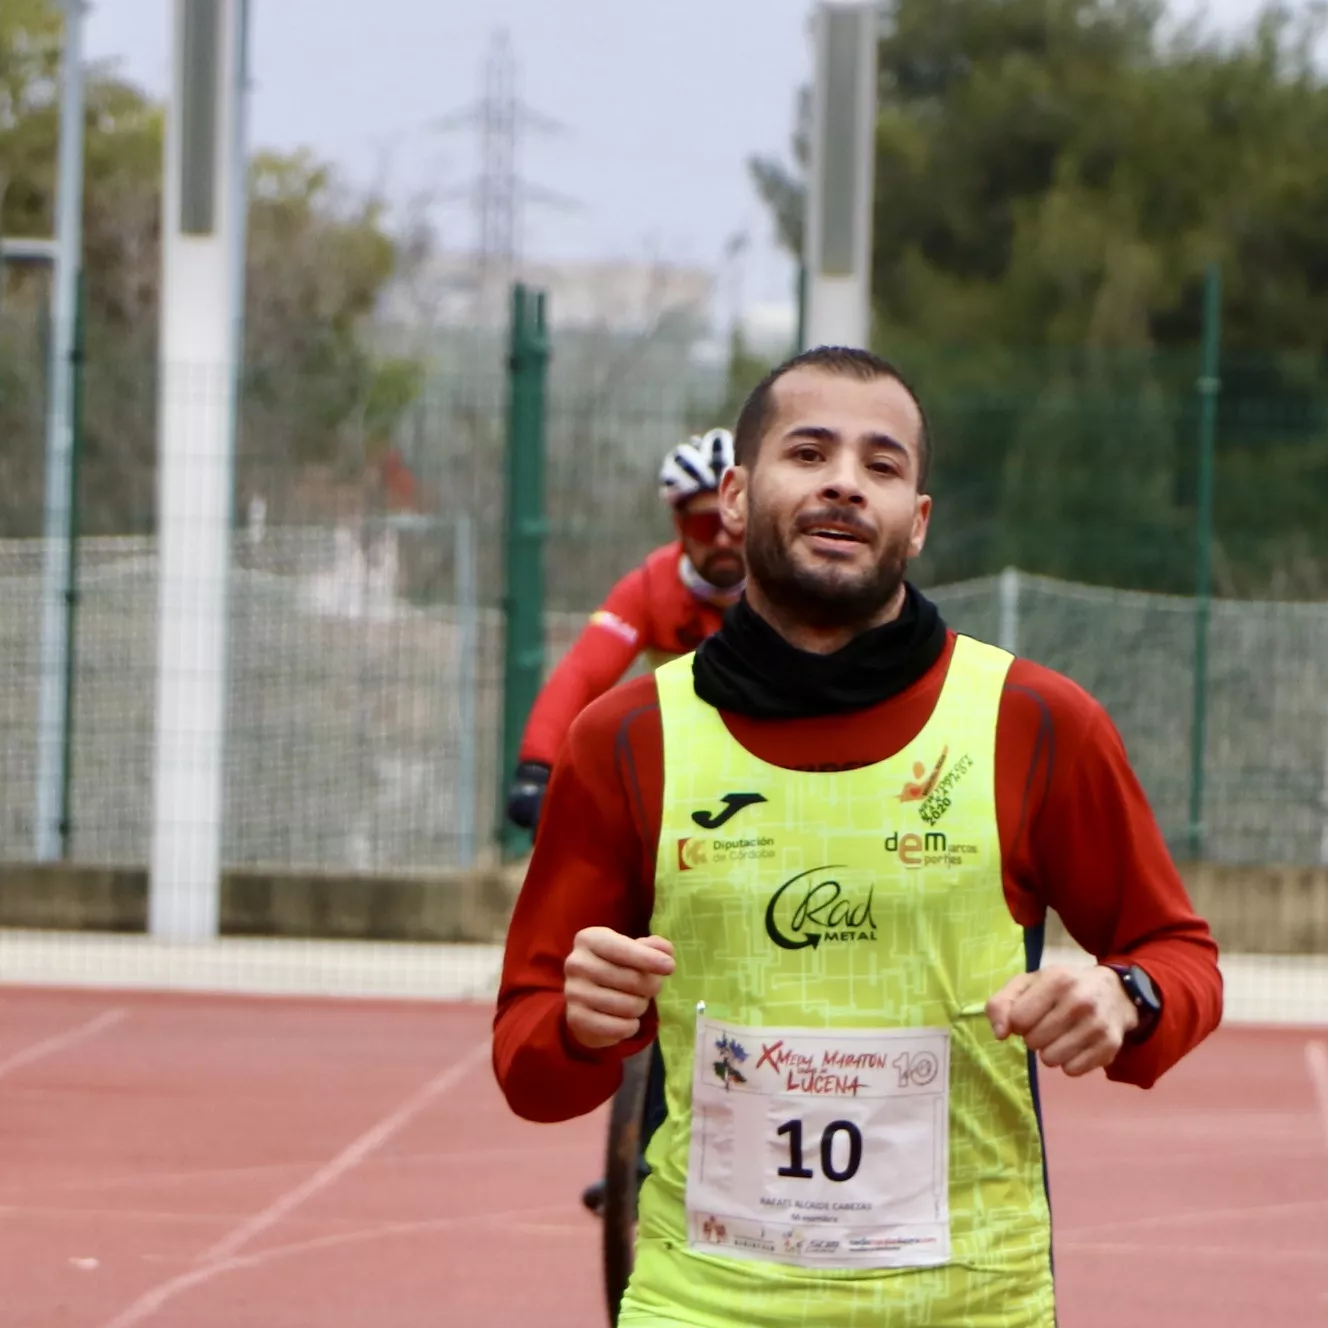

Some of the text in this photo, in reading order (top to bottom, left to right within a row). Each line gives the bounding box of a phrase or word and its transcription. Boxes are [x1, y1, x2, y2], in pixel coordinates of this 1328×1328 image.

[930, 797, 951, 827] 2020
[713, 837, 775, 851] Diputación
[713, 853, 727, 862] de
[791, 879, 878, 932] Rad
[824, 931, 878, 941] METAL
[786, 1070, 871, 1097] LUCENA
[776, 1118, 863, 1182] 10
